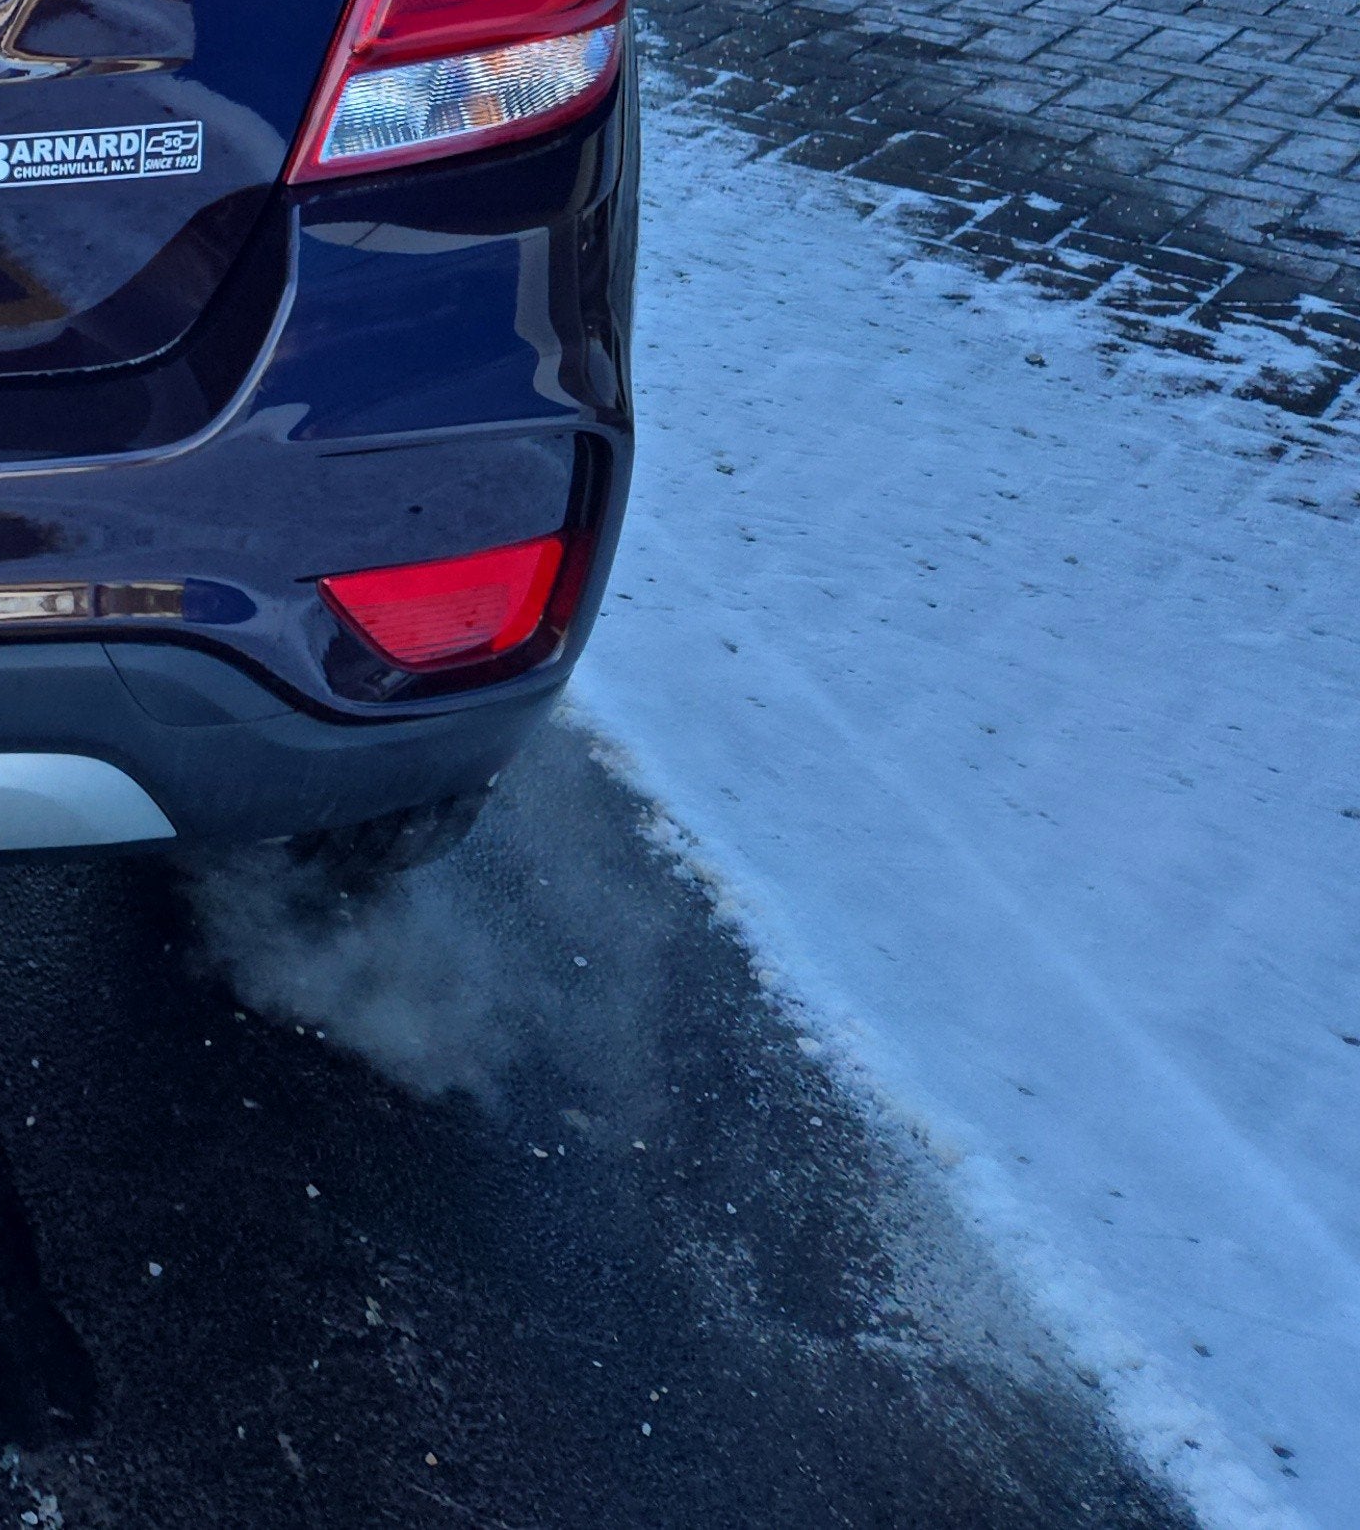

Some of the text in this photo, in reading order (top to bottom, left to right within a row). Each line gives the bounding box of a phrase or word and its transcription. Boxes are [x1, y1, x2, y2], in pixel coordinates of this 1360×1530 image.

[164, 137, 182, 149] 50
[13, 158, 135, 179] CHURCHVILLE, N.Y.
[145, 155, 197, 170] SINCE 1972
